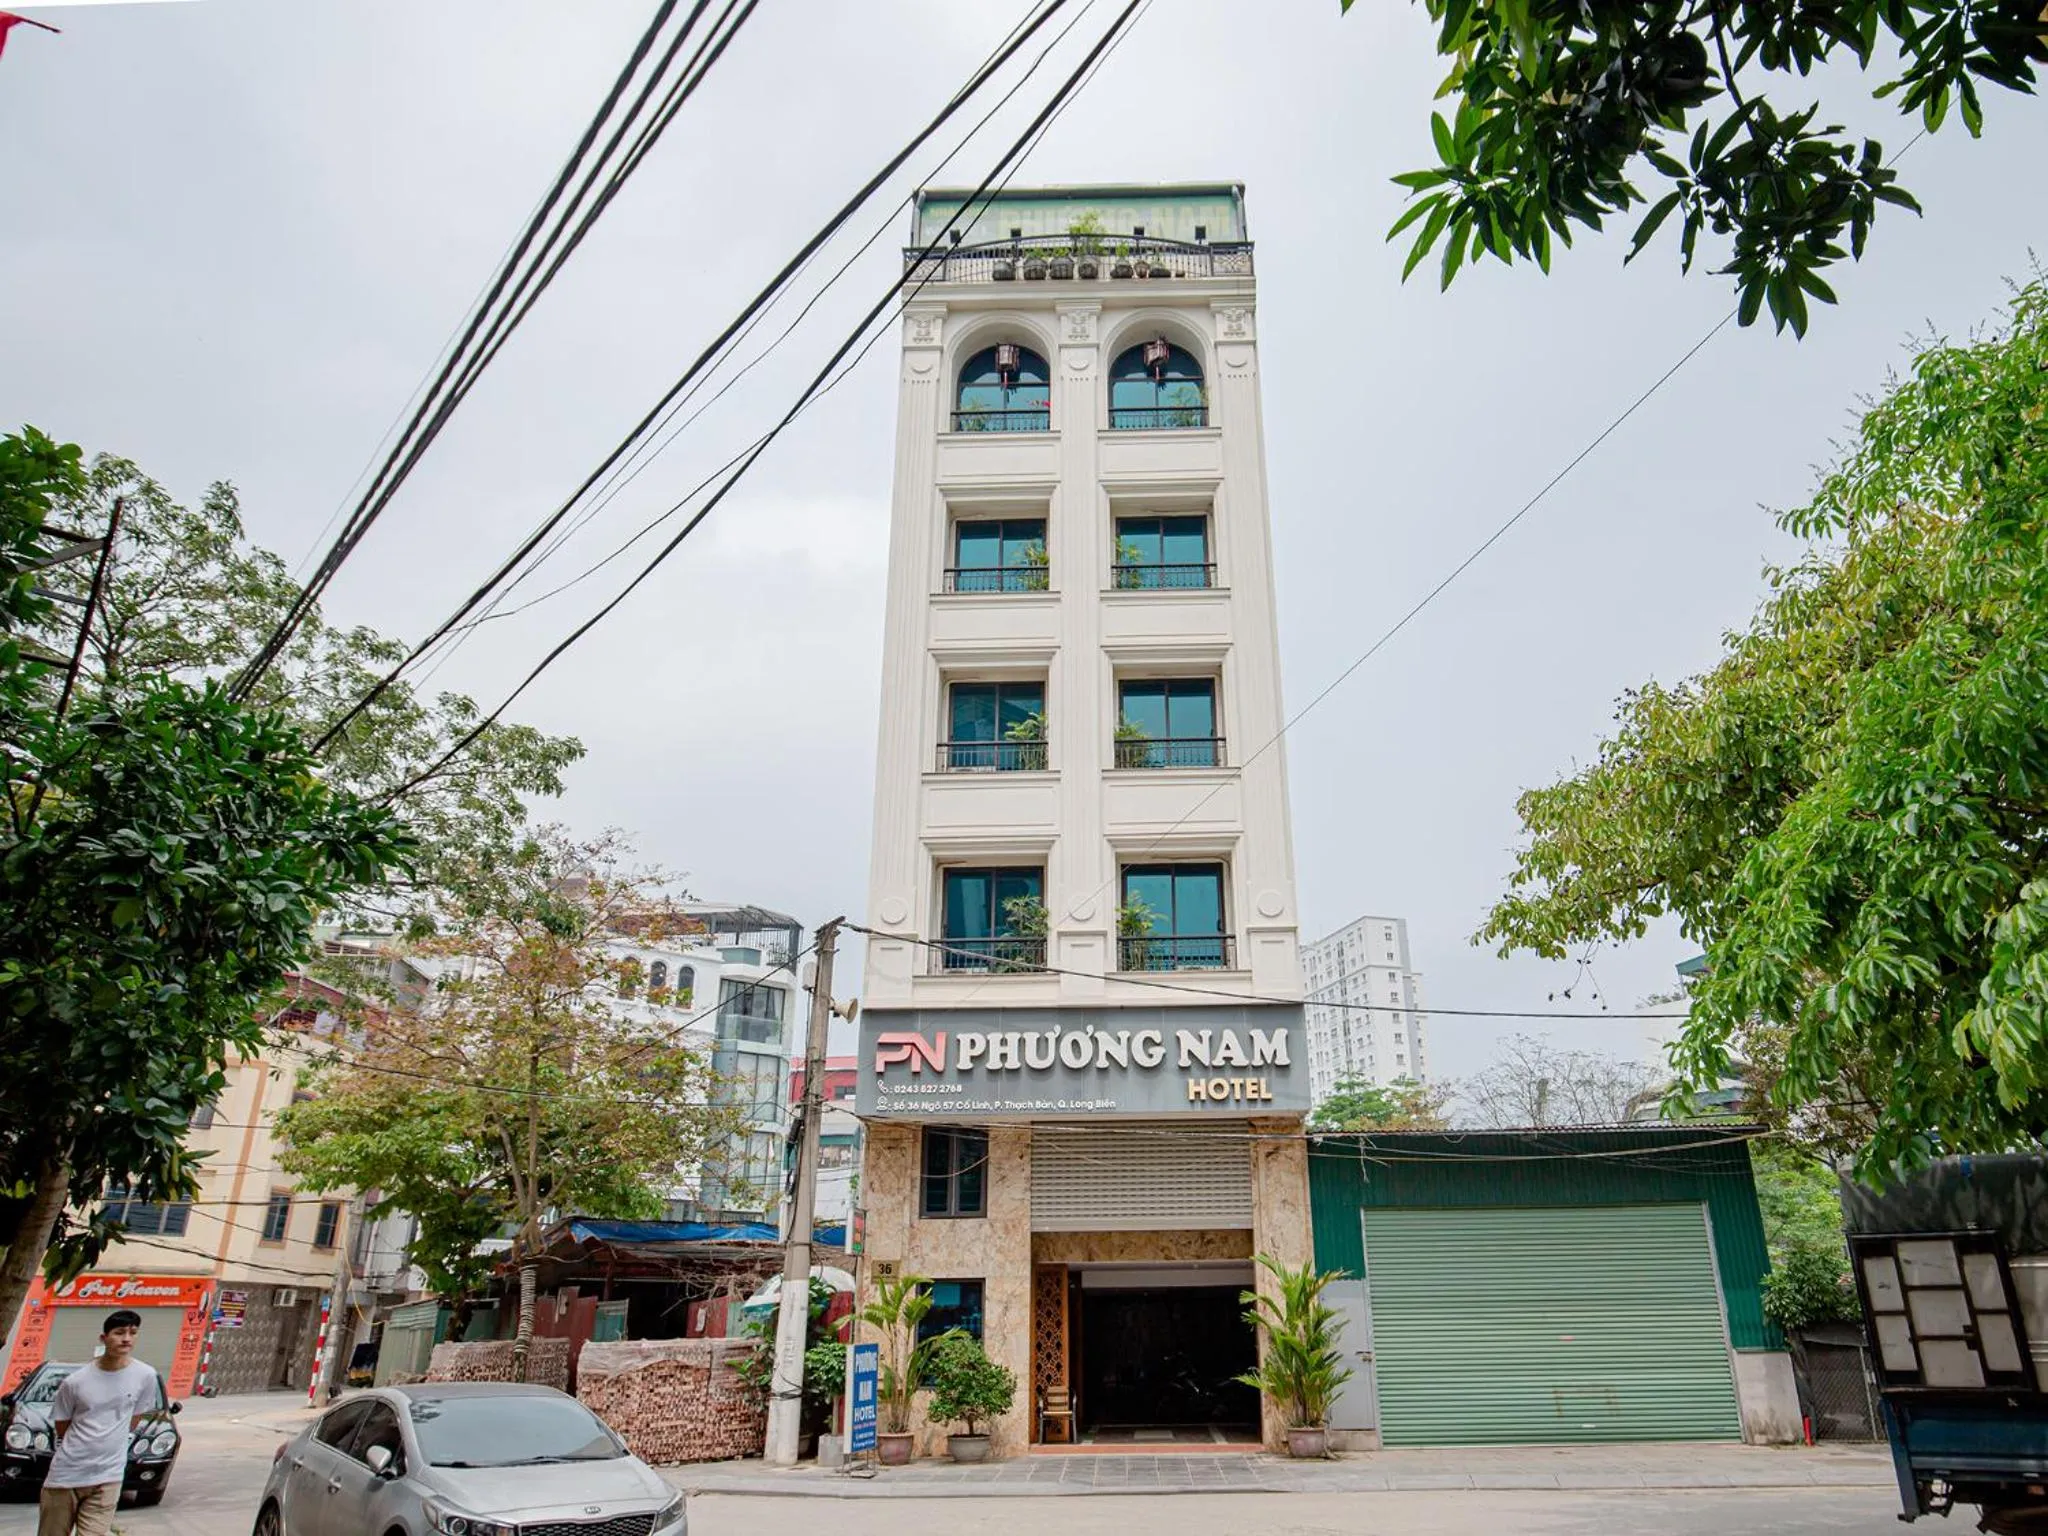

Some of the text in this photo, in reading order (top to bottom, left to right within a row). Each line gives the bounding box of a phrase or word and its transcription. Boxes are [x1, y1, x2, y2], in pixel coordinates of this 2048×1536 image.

[875, 1024, 1292, 1073] PN PHƯƠNG NAM
[1186, 1076, 1273, 1102] HOTEL
[878, 1263, 892, 1275] 36
[854, 1404, 876, 1422] HOTEL
